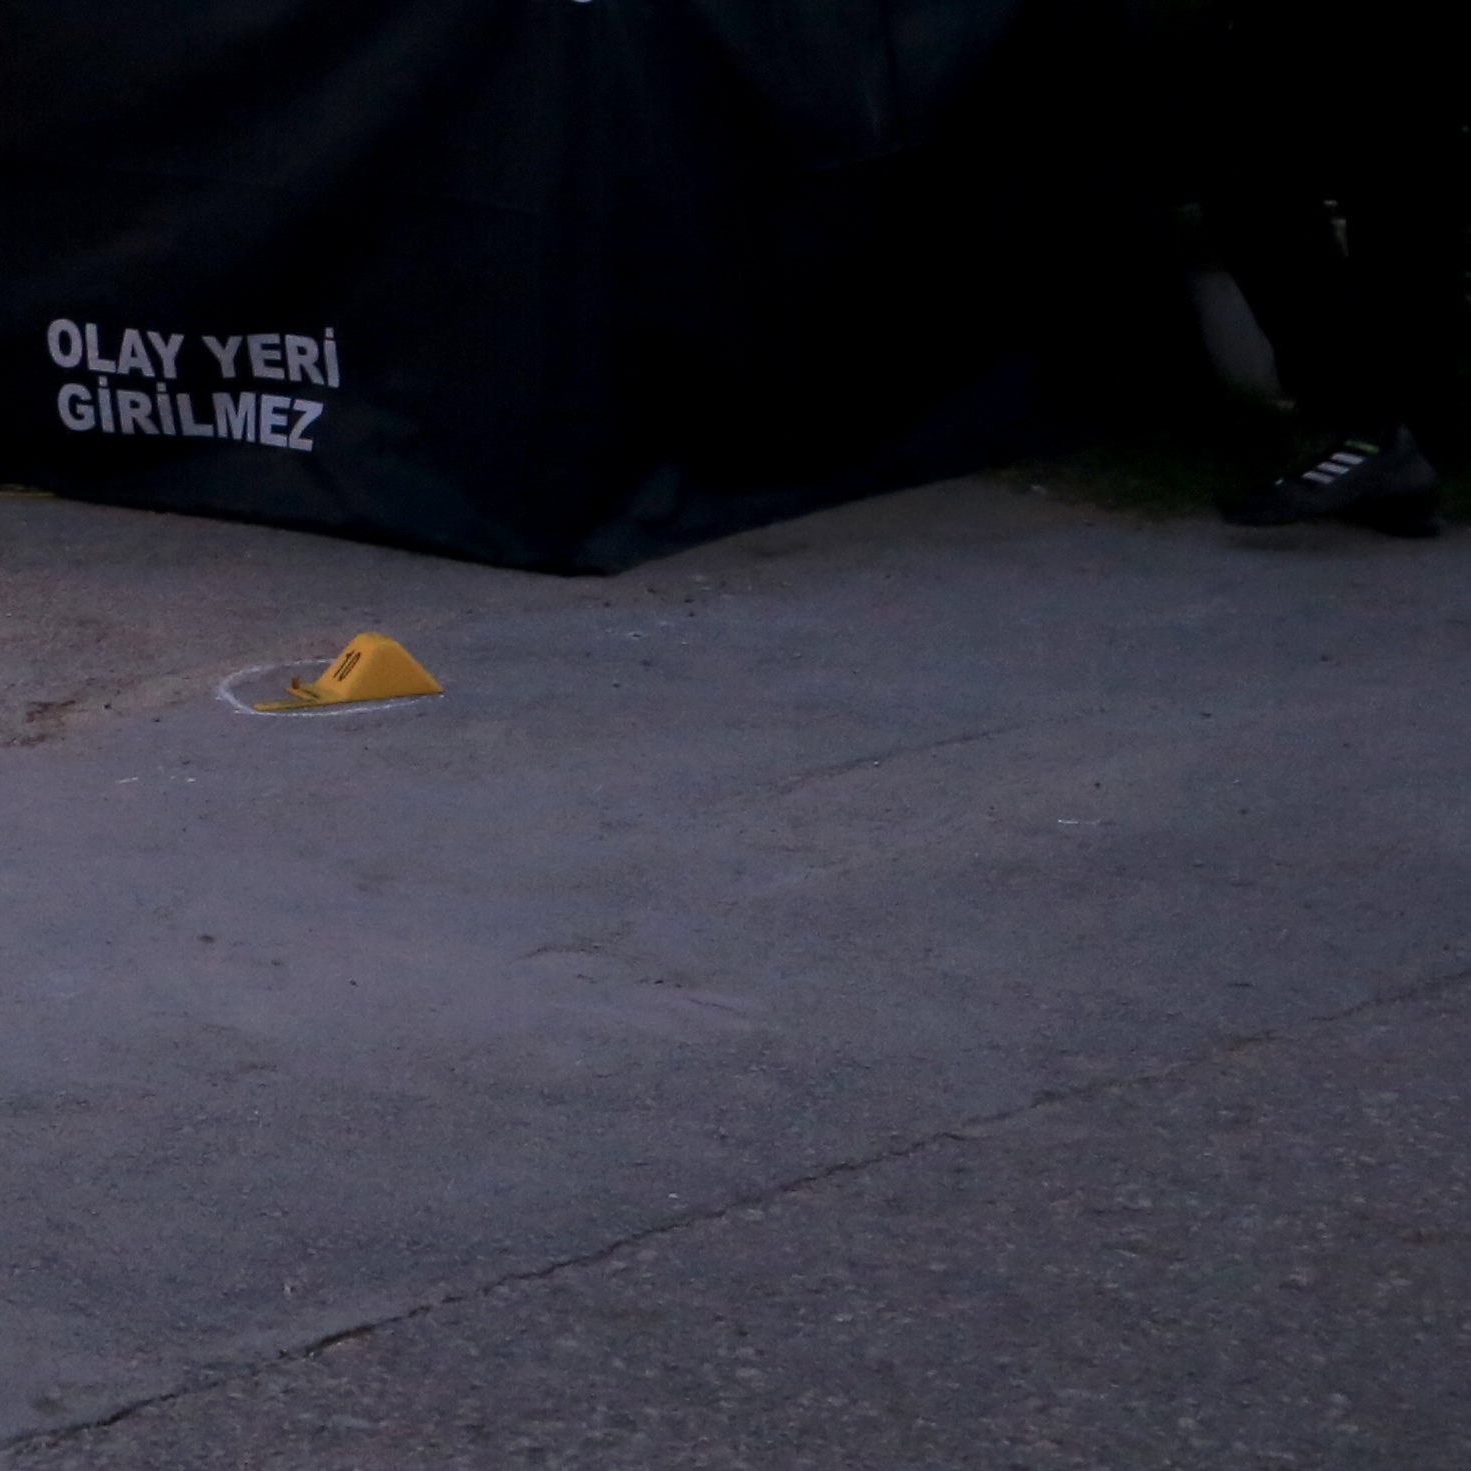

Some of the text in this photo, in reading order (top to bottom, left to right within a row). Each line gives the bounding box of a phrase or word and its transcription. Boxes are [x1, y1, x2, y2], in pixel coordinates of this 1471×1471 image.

[46, 317, 341, 389] OLAY YERİ
[57, 376, 325, 453] GİRİLMEZ
